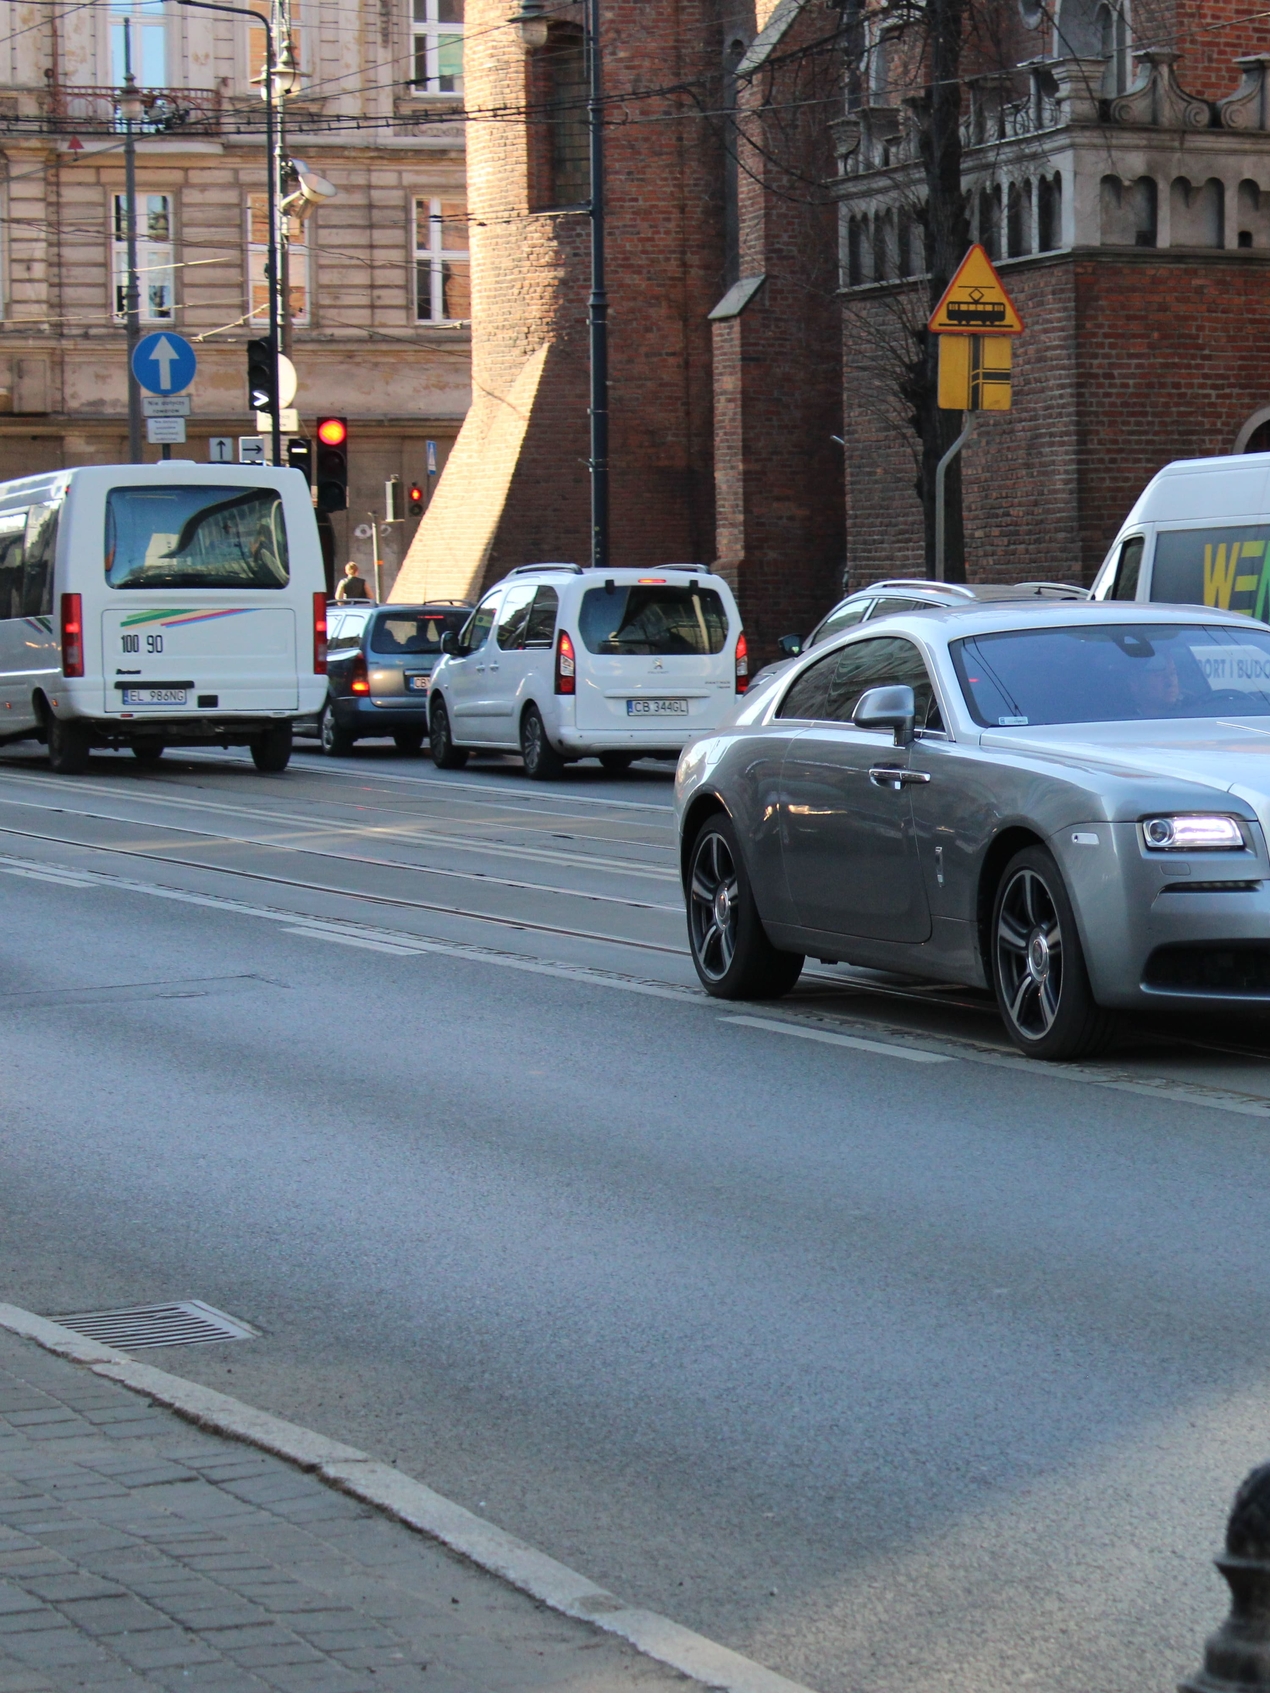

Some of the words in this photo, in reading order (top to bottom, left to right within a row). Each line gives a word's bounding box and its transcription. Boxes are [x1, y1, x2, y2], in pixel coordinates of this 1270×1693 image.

[121, 635, 139, 653] 100
[147, 635, 163, 653] 90
[130, 691, 143, 701] EL
[150, 691, 184, 701] 986NG
[635, 702, 650, 712] CB
[655, 702, 686, 712] 344GL
